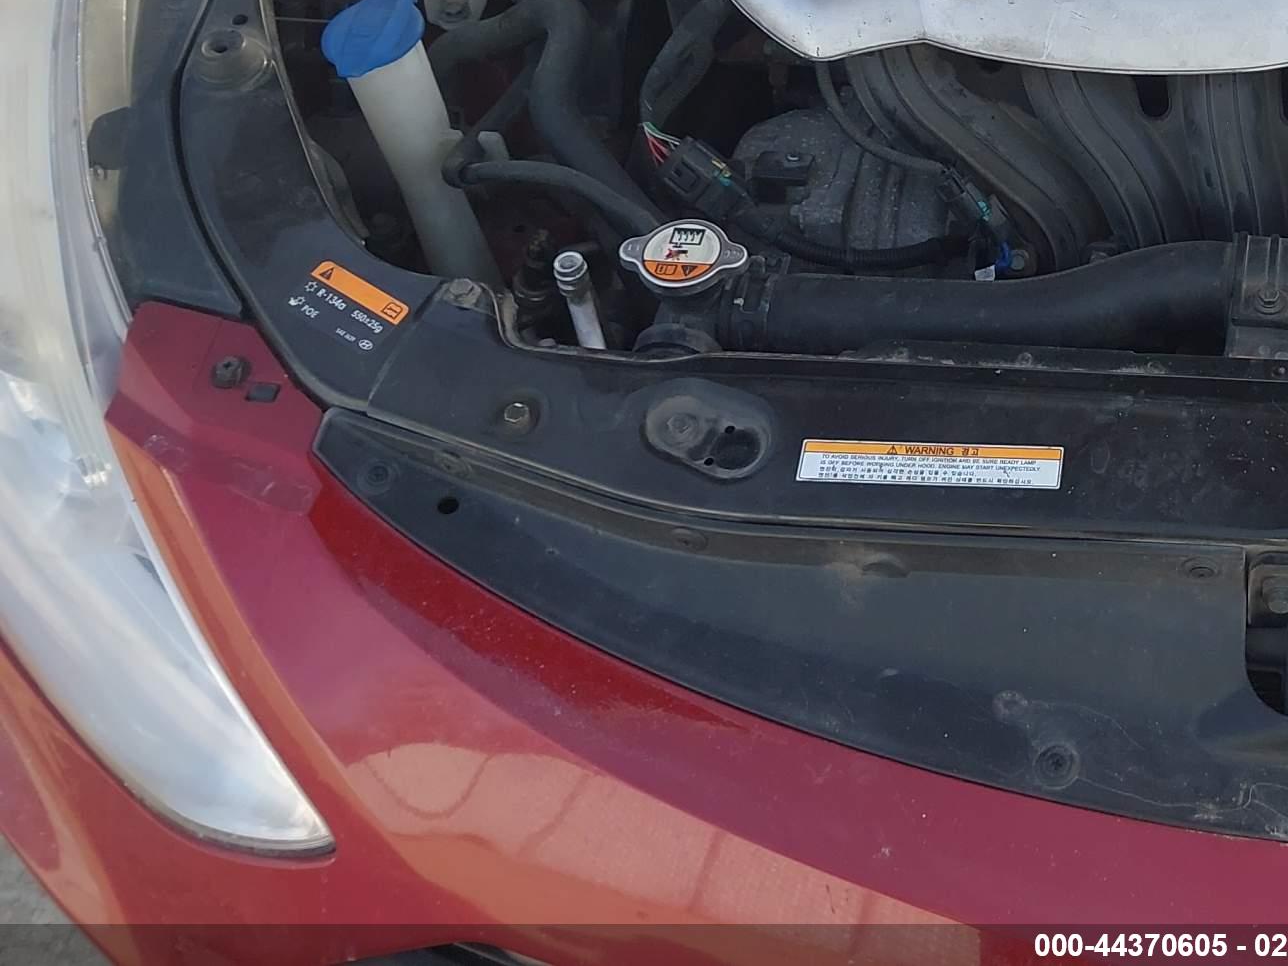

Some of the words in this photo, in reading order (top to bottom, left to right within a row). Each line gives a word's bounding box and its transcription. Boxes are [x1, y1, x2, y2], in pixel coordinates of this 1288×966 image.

[316, 288, 347, 311] R-134a
[301, 304, 320, 319] POE
[905, 446, 954, 455] WARNING
